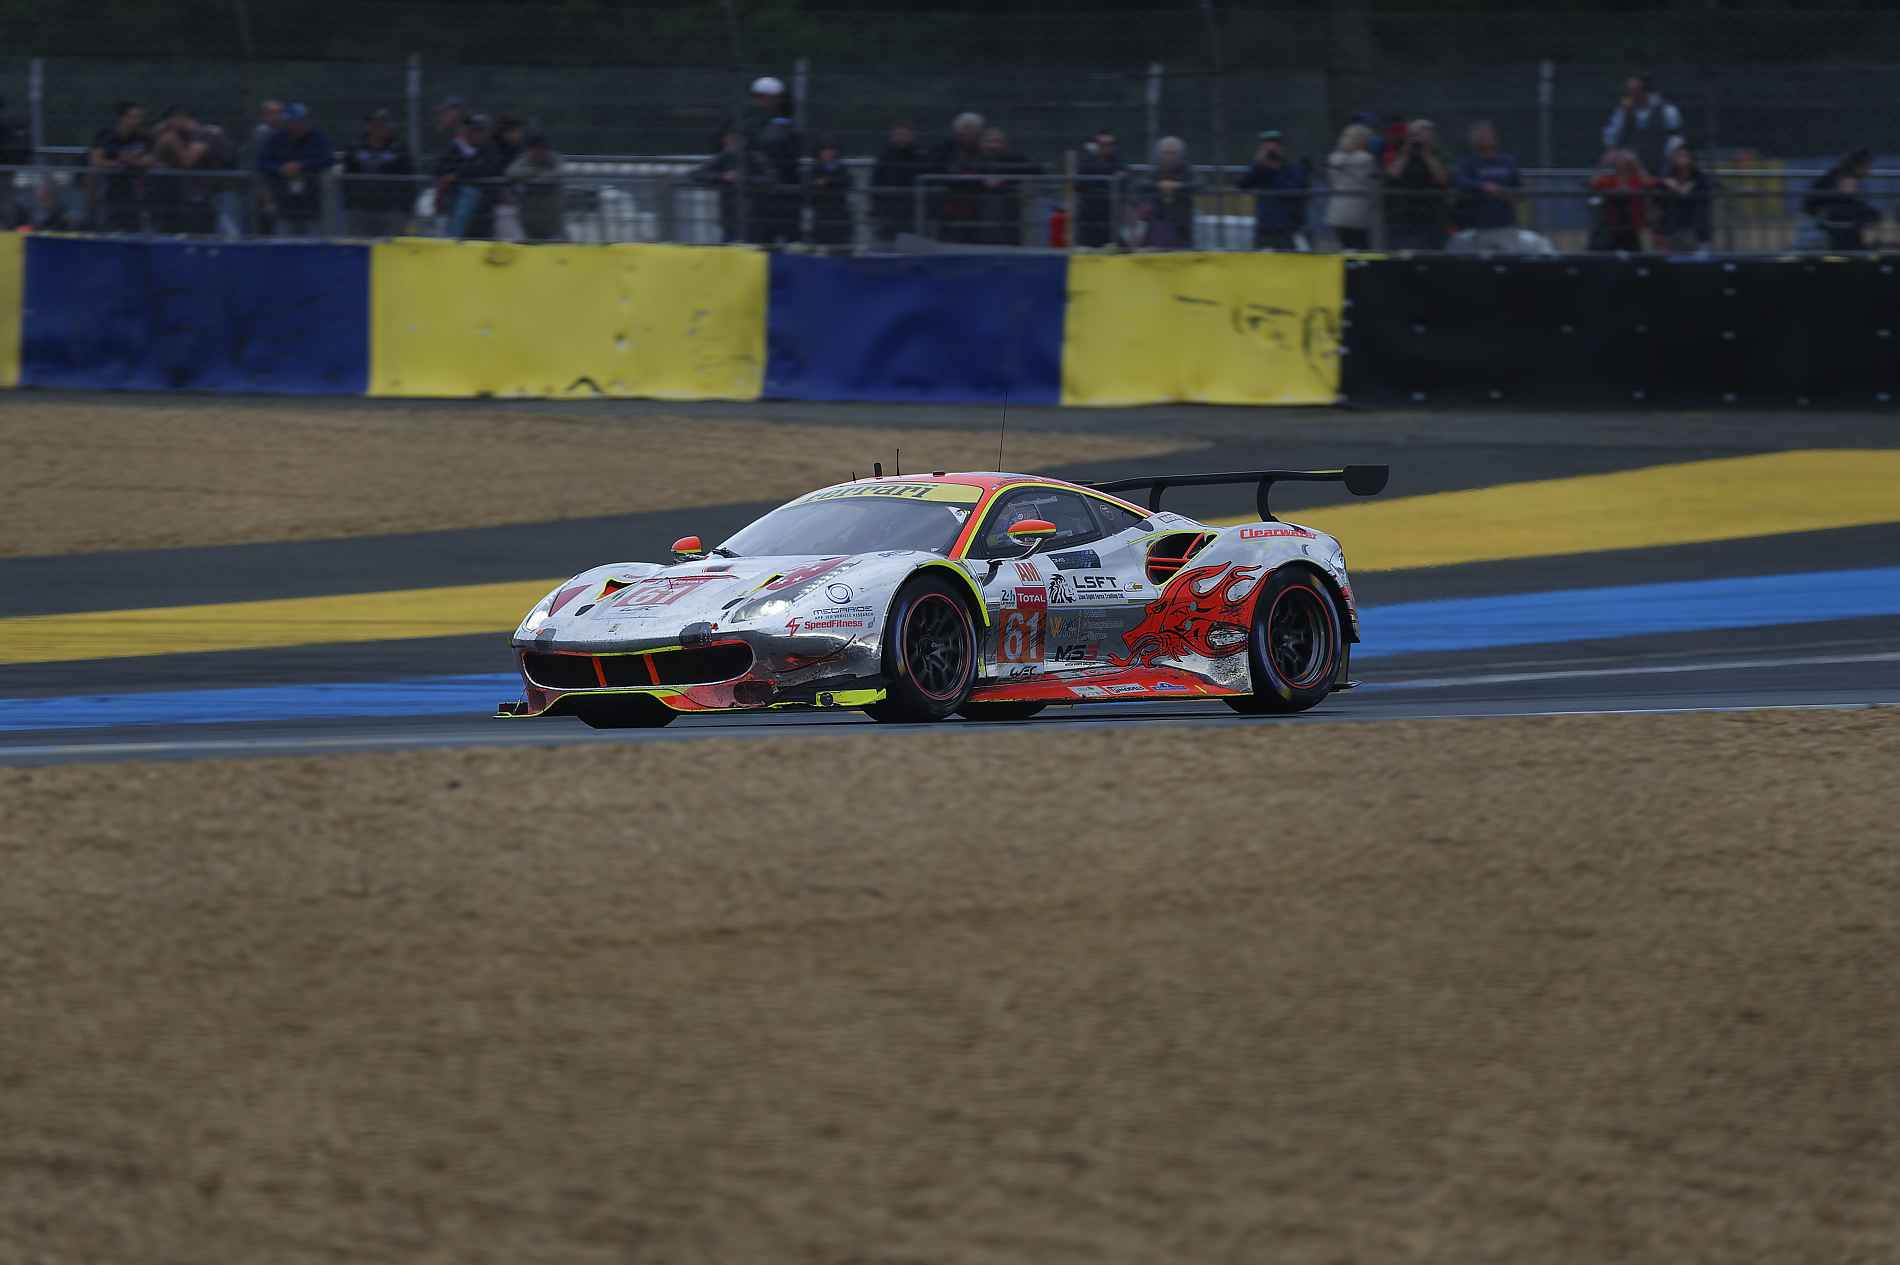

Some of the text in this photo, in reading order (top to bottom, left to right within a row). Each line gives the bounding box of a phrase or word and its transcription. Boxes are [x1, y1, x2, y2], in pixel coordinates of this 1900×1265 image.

[1073, 575, 1117, 588] LSFT
[1017, 592, 1046, 602] TOTAL
[804, 620, 863, 630] SpeedFitness
[1005, 612, 1040, 659] 61
